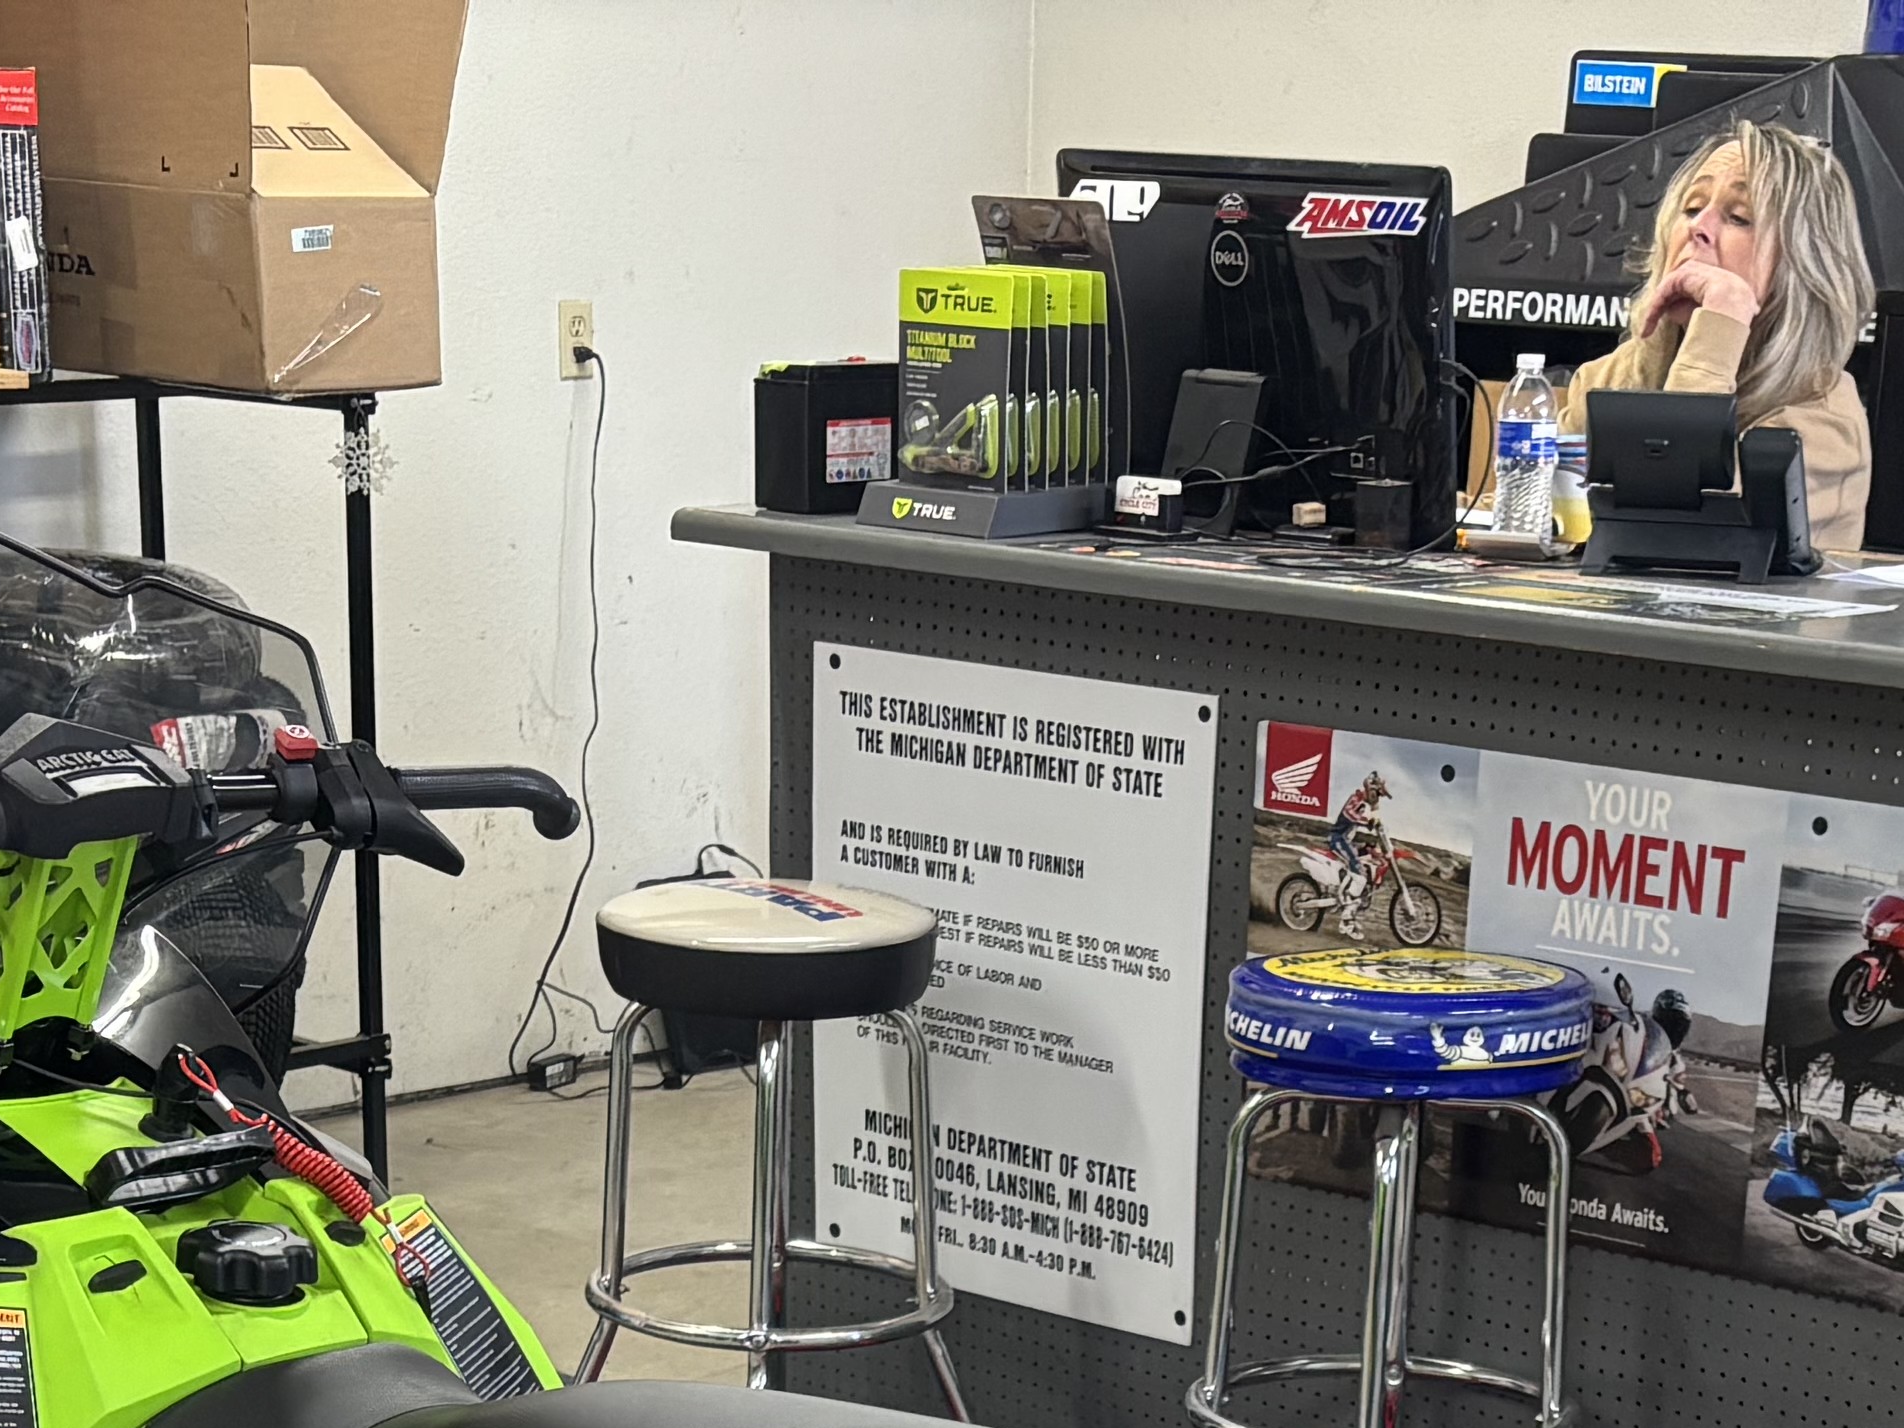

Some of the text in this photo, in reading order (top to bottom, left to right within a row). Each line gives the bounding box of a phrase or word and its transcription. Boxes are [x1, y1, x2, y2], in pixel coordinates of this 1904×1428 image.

[1583, 75, 1646, 95] BILSTEIN
[1296, 197, 1428, 234] AMSOIL
[46, 253, 95, 276] NDA
[1215, 250, 1245, 266] DELL
[941, 294, 994, 313] TRUE
[912, 503, 955, 520] TRUE
[840, 690, 1185, 766] THIS ESTABLISHMENT IS REGISTERED WITH
[36, 748, 135, 771] ARCTIC CAT
[856, 727, 1164, 798] THE MICHIGAN DEPARTMENT OF STATE
[1271, 790, 1321, 807] HONDA
[1586, 780, 1673, 831] YOUR
[840, 849, 976, 885] A CUSTOMER WITH A:
[841, 819, 1084, 879] AND IS REQUIRED BY LAW TO FURNISH
[1507, 816, 1746, 919] MOMENT
[963, 914, 973, 927] IF
[977, 916, 1022, 937] REPAIRS
[1027, 924, 1053, 943] WILL
[1057, 931, 1073, 946] BE
[1103, 940, 1121, 956] OR
[1124, 944, 1160, 963] MORE
[1551, 899, 1681, 957] AWAITS.
[964, 932, 974, 945] IF
[978, 934, 1025, 955] REPAIRS
[1028, 942, 1055, 961] WILL
[1058, 949, 1074, 964] BE
[1078, 952, 1108, 971] LESS
[1112, 958, 1143, 979] THAN
[957, 963, 1043, 992] OF LABOR AND
[857, 1024, 872, 1039] OF
[875, 1027, 899, 1045] THIS
[942, 1040, 992, 1067] FACILITY.
[921, 1004, 1075, 1049] REGARDING SERVICE WORK
[1227, 1010, 1313, 1052] CHELIN
[1497, 1020, 1592, 1056] MICHEL
[922, 1022, 976, 1048] DIRECTED
[979, 1034, 1011, 1055] FIRST
[1014, 1041, 1030, 1058] TO
[1032, 1044, 1054, 1062] THE
[1058, 1048, 1114, 1074] MANAGER
[832, 1163, 889, 1199] TOLL-FREE
[947, 1127, 1137, 1193] DEPARTMENT OF STATE
[853, 1136, 1149, 1228] P.O. LANSING, MI 48909
[1518, 1183, 1670, 1235] You onda Awaits.
[969, 1232, 997, 1256] 8:30
